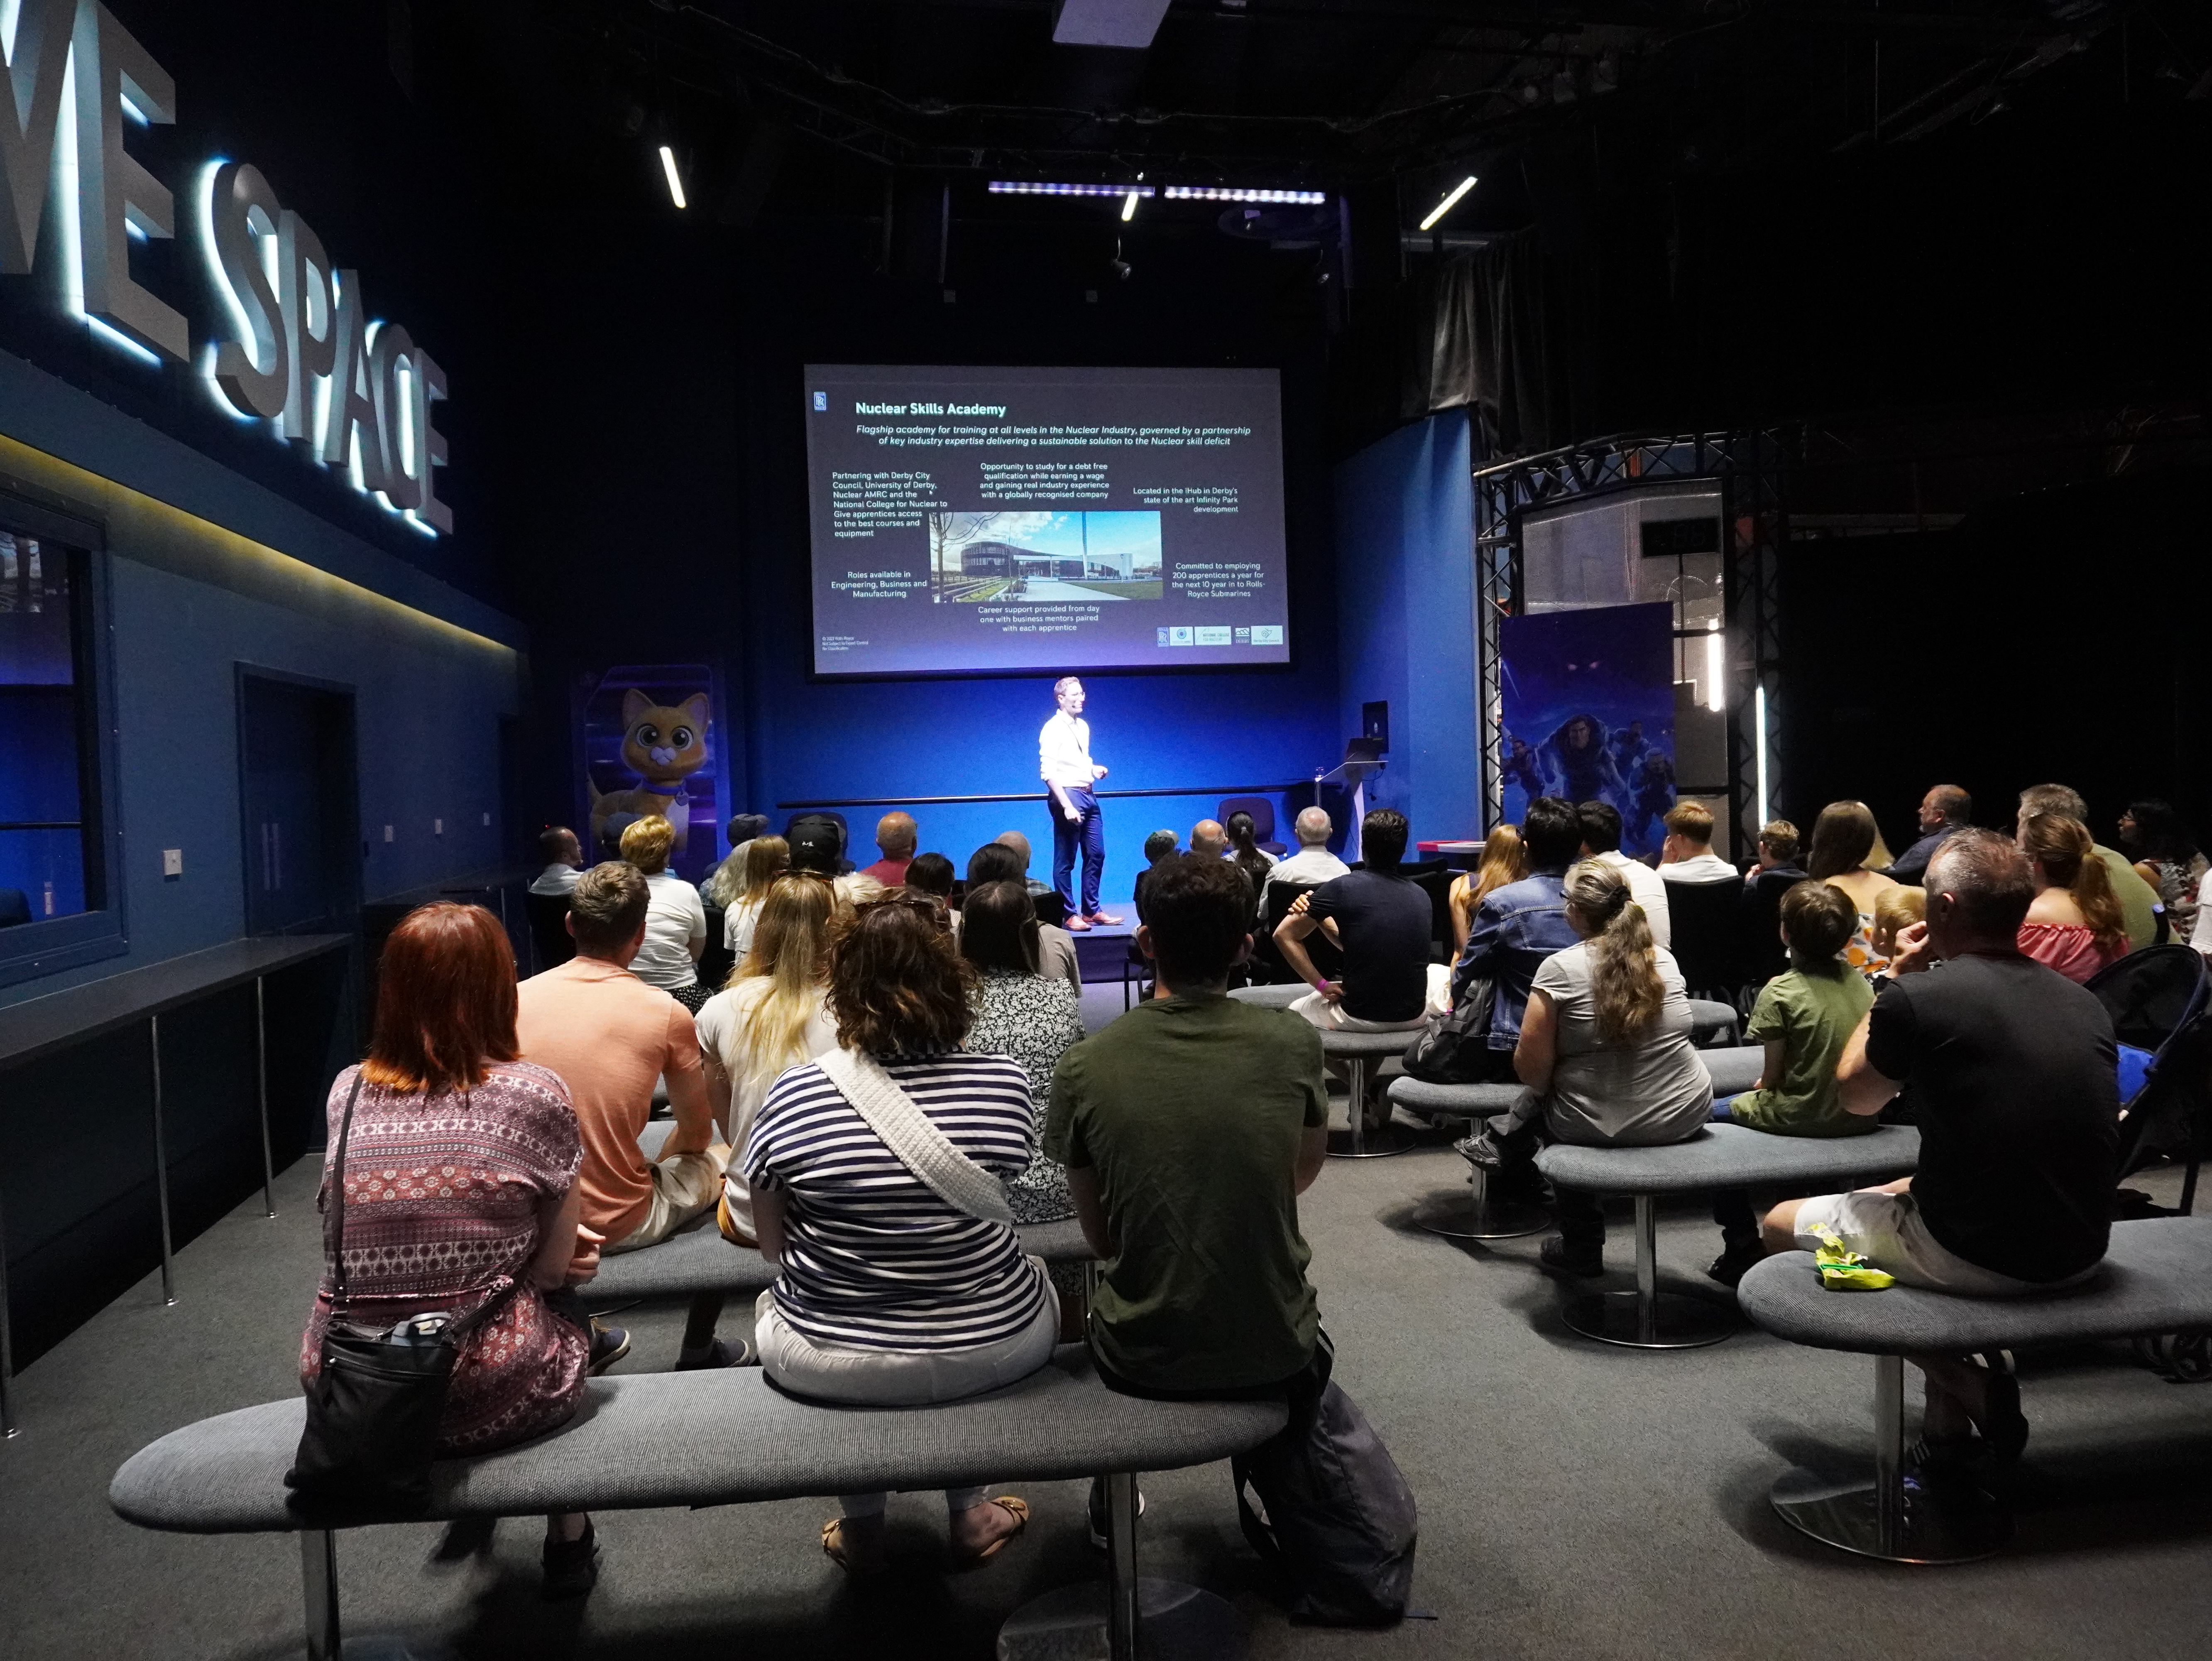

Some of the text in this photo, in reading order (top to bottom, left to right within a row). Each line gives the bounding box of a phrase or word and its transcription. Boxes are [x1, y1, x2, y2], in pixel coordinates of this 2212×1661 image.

[211, 163, 453, 535] SPACE
[856, 402, 1006, 417] Nuclear Skills Academy
[856, 425, 894, 435] Flagship
[896, 425, 936, 435] academy
[938, 425, 951, 434] for
[953, 426, 987, 436] training
[1013, 426, 1037, 434] levels
[1066, 426, 1099, 434] Nuclear
[1101, 426, 1138, 436] Industry,
[1140, 426, 1180, 436] governed
[1182, 426, 1192, 436] by
[1202, 426, 1250, 436] partnership
[878, 436, 888, 444] of
[890, 436, 905, 446] key
[907, 436, 943, 446] industry
[945, 437, 984, 446] expertise
[986, 437, 1029, 446] delivering
[980, 463, 1024, 471] Opportunity
[1035, 463, 1055, 471] study
[832, 472, 871, 480] Partnering
[891, 472, 913, 480] Derby
[915, 472, 930, 480] City
[984, 472, 1028, 481] qualification
[1050, 473, 1078, 481] earning
[865, 482, 902, 490] University
[913, 481, 937, 490] Derby,
[995, 482, 1022, 490] gaining
[1040, 481, 1069, 490] industry
[1004, 491, 1033, 500] globally
[1035, 491, 1074, 499] recognised
[1212, 487, 1238, 495] Derby's
[866, 500, 895, 509] College
[1197, 496, 1220, 505] Infinity
[853, 510, 896, 519] apprentices
[834, 530, 874, 538] equipment
[1188, 572, 1229, 580] apprentices
[831, 581, 878, 590] Engineering,
[853, 590, 906, 598] Manufacturing
[1187, 590, 1209, 599] Royce
[1035, 605, 1067, 614] provided
[1076, 614, 1099, 622] paired
[1039, 624, 1077, 632] apprentice
